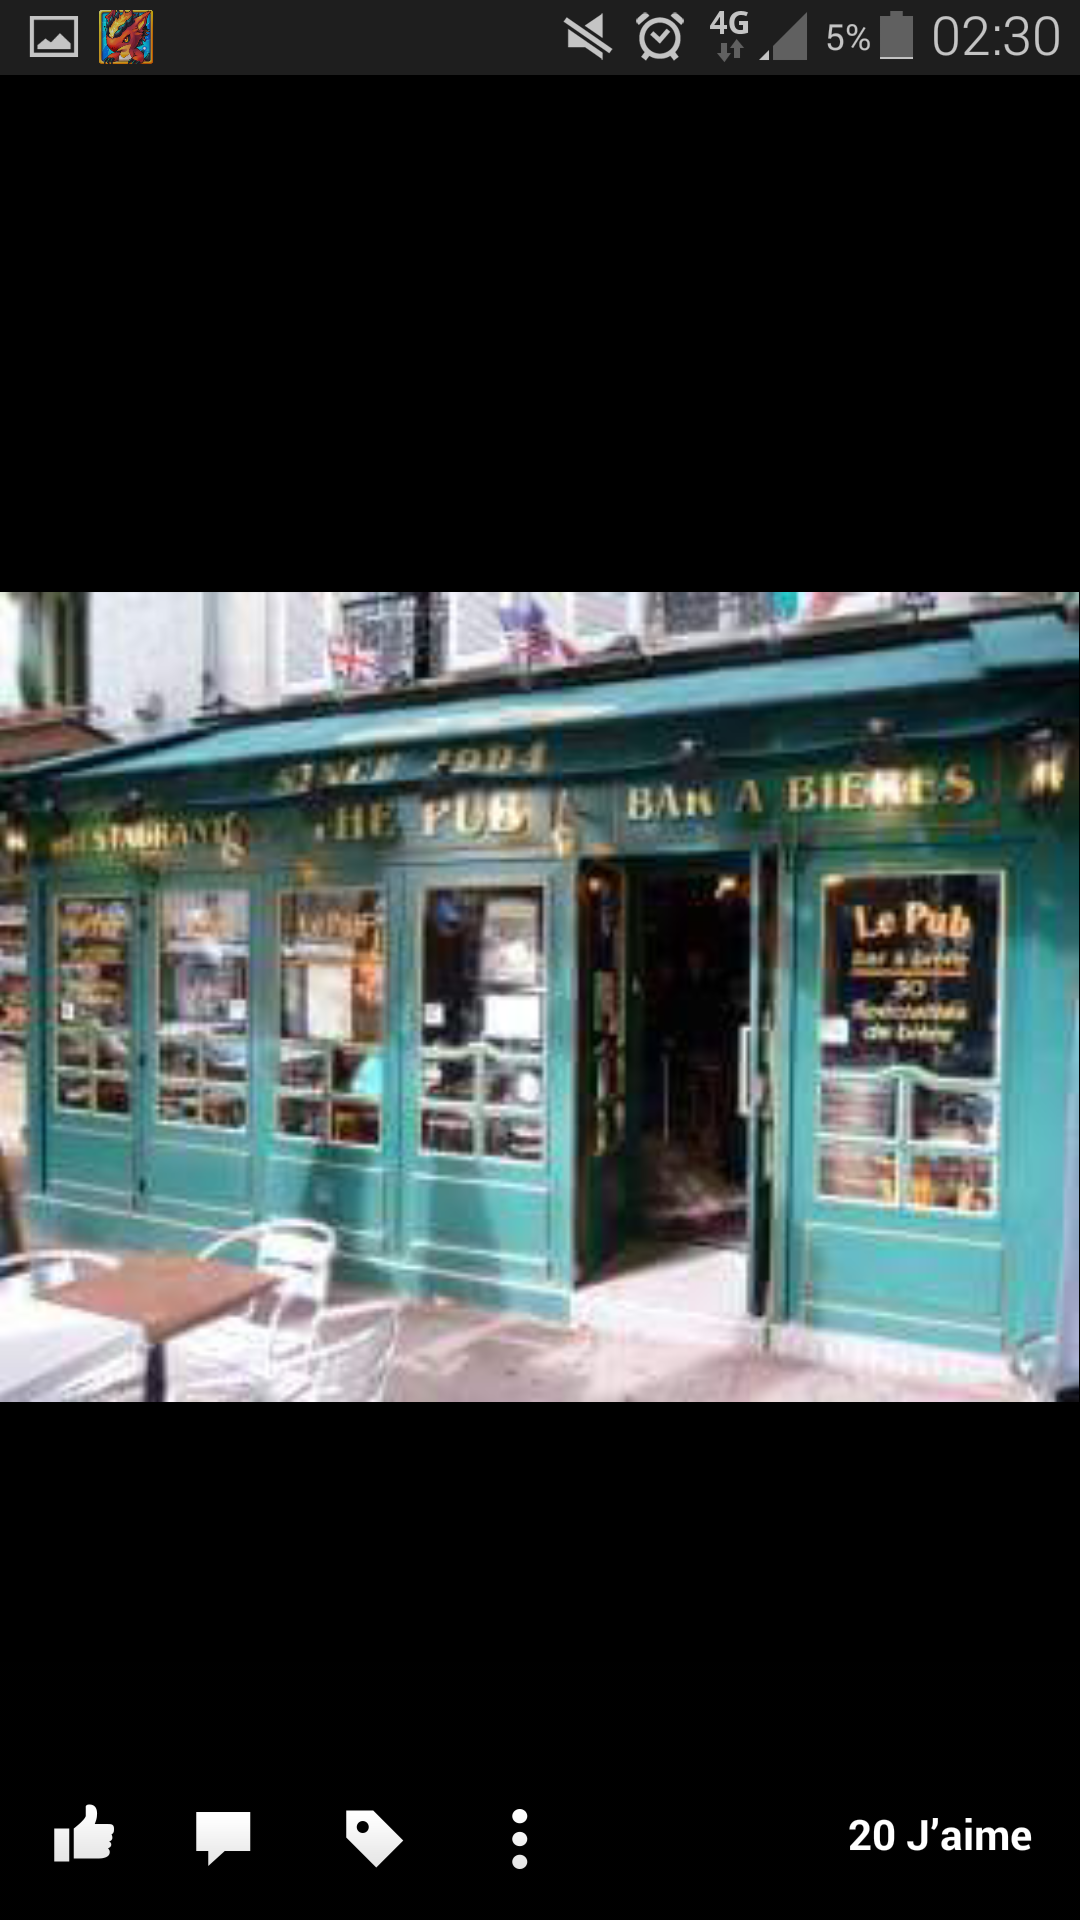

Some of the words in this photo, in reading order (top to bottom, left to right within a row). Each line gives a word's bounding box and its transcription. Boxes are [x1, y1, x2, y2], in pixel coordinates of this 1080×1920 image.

[274, 750, 402, 796] SINCE
[418, 785, 530, 838] PUB
[627, 783, 713, 821] BAR
[853, 905, 897, 943] Le
[905, 901, 972, 939] Pub
